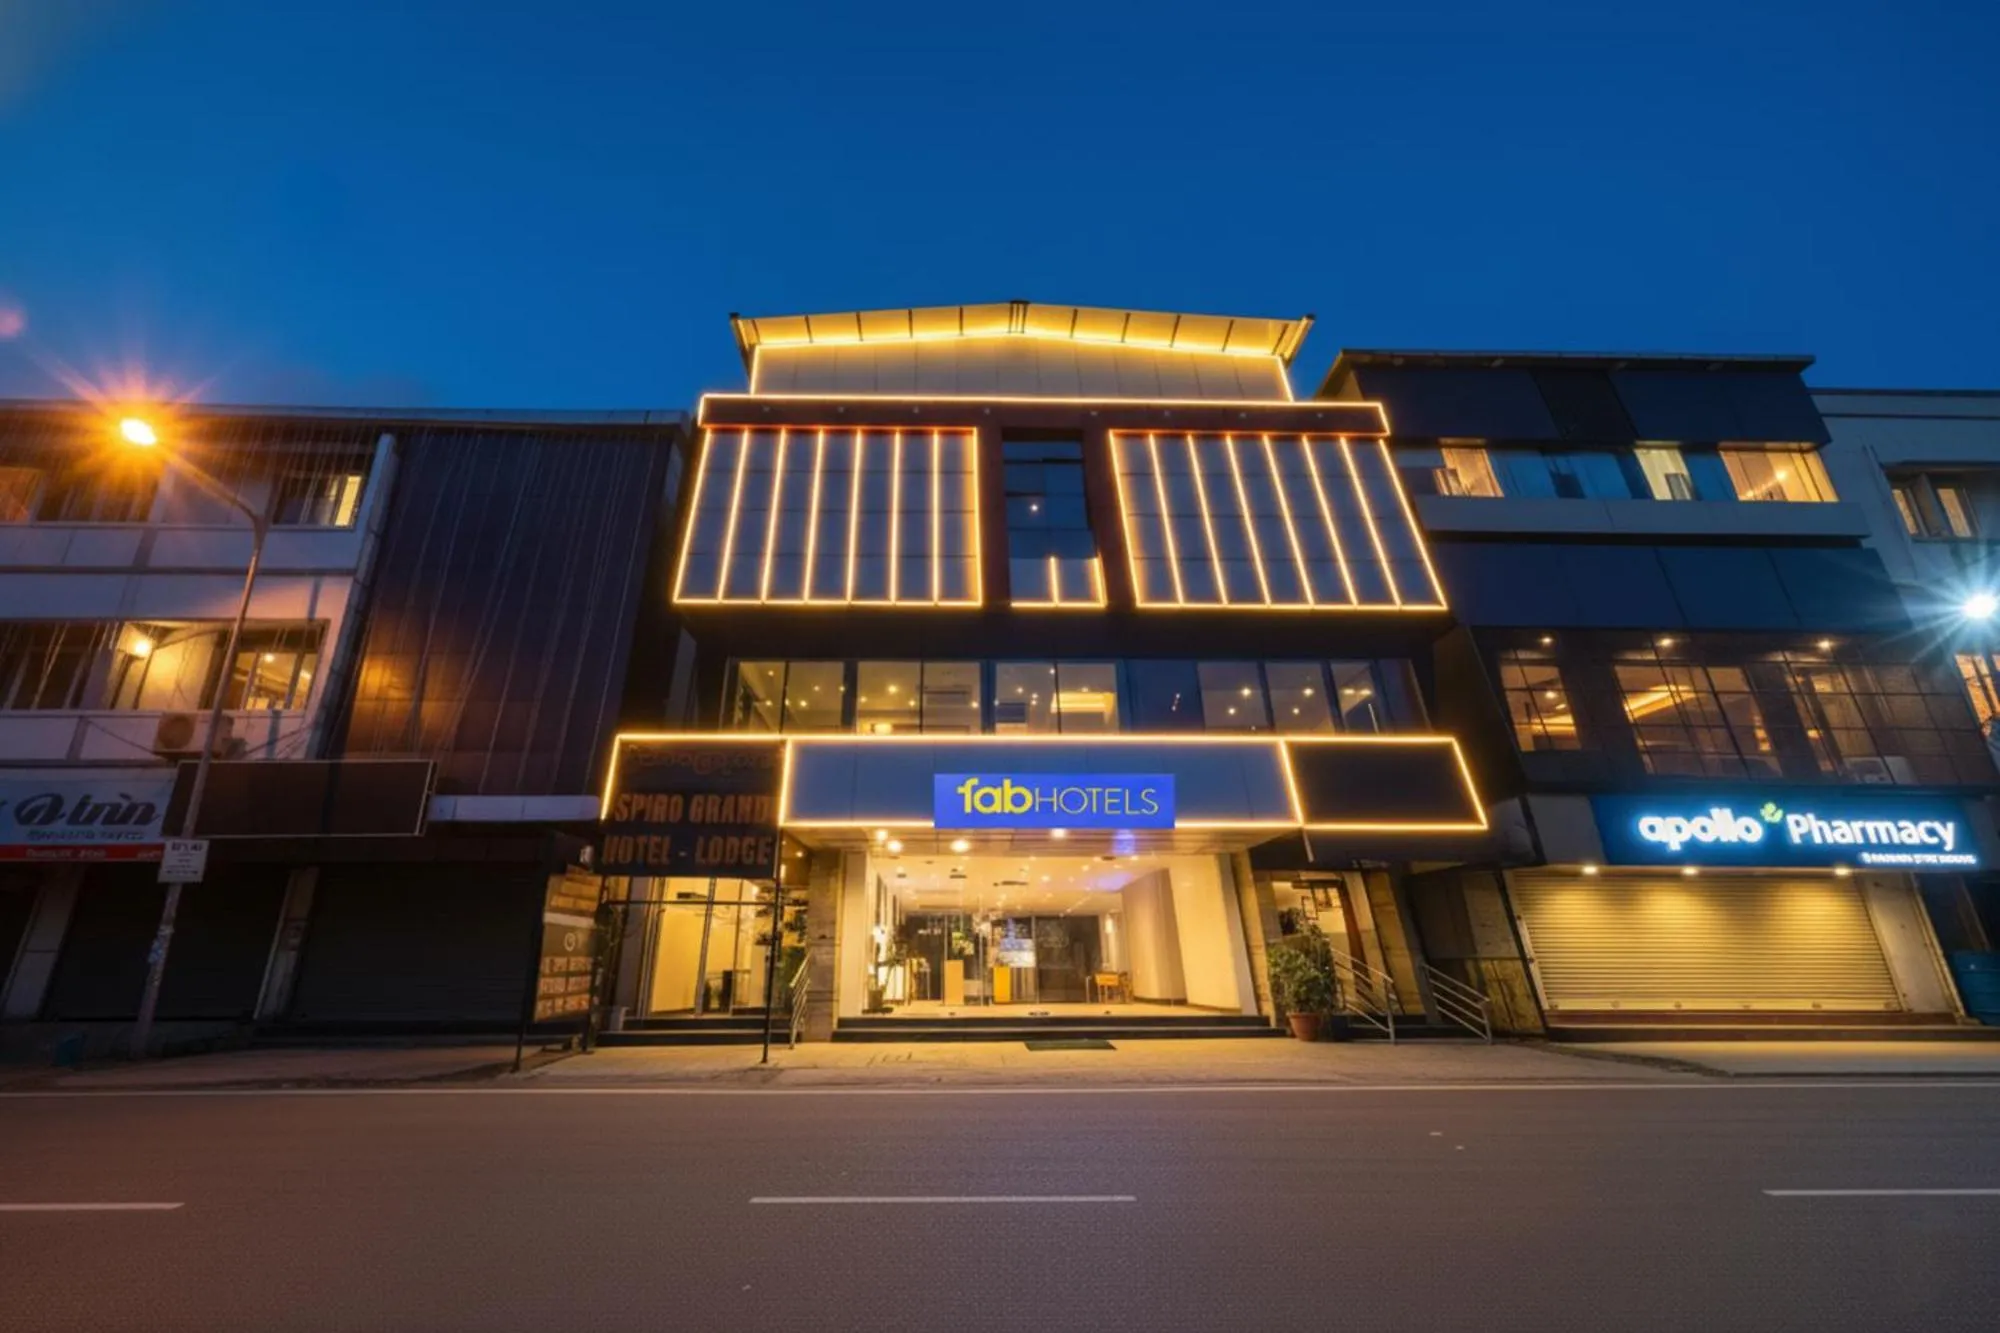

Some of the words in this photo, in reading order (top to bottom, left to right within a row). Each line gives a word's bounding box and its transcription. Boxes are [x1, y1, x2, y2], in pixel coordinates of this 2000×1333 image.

[614, 793, 684, 823] SPIRO
[689, 793, 772, 823] GRAND
[1638, 808, 1763, 851] apollo
[1786, 813, 1955, 851] Pharmacy
[601, 833, 672, 865] HOTEL
[694, 835, 773, 866] LODGE
